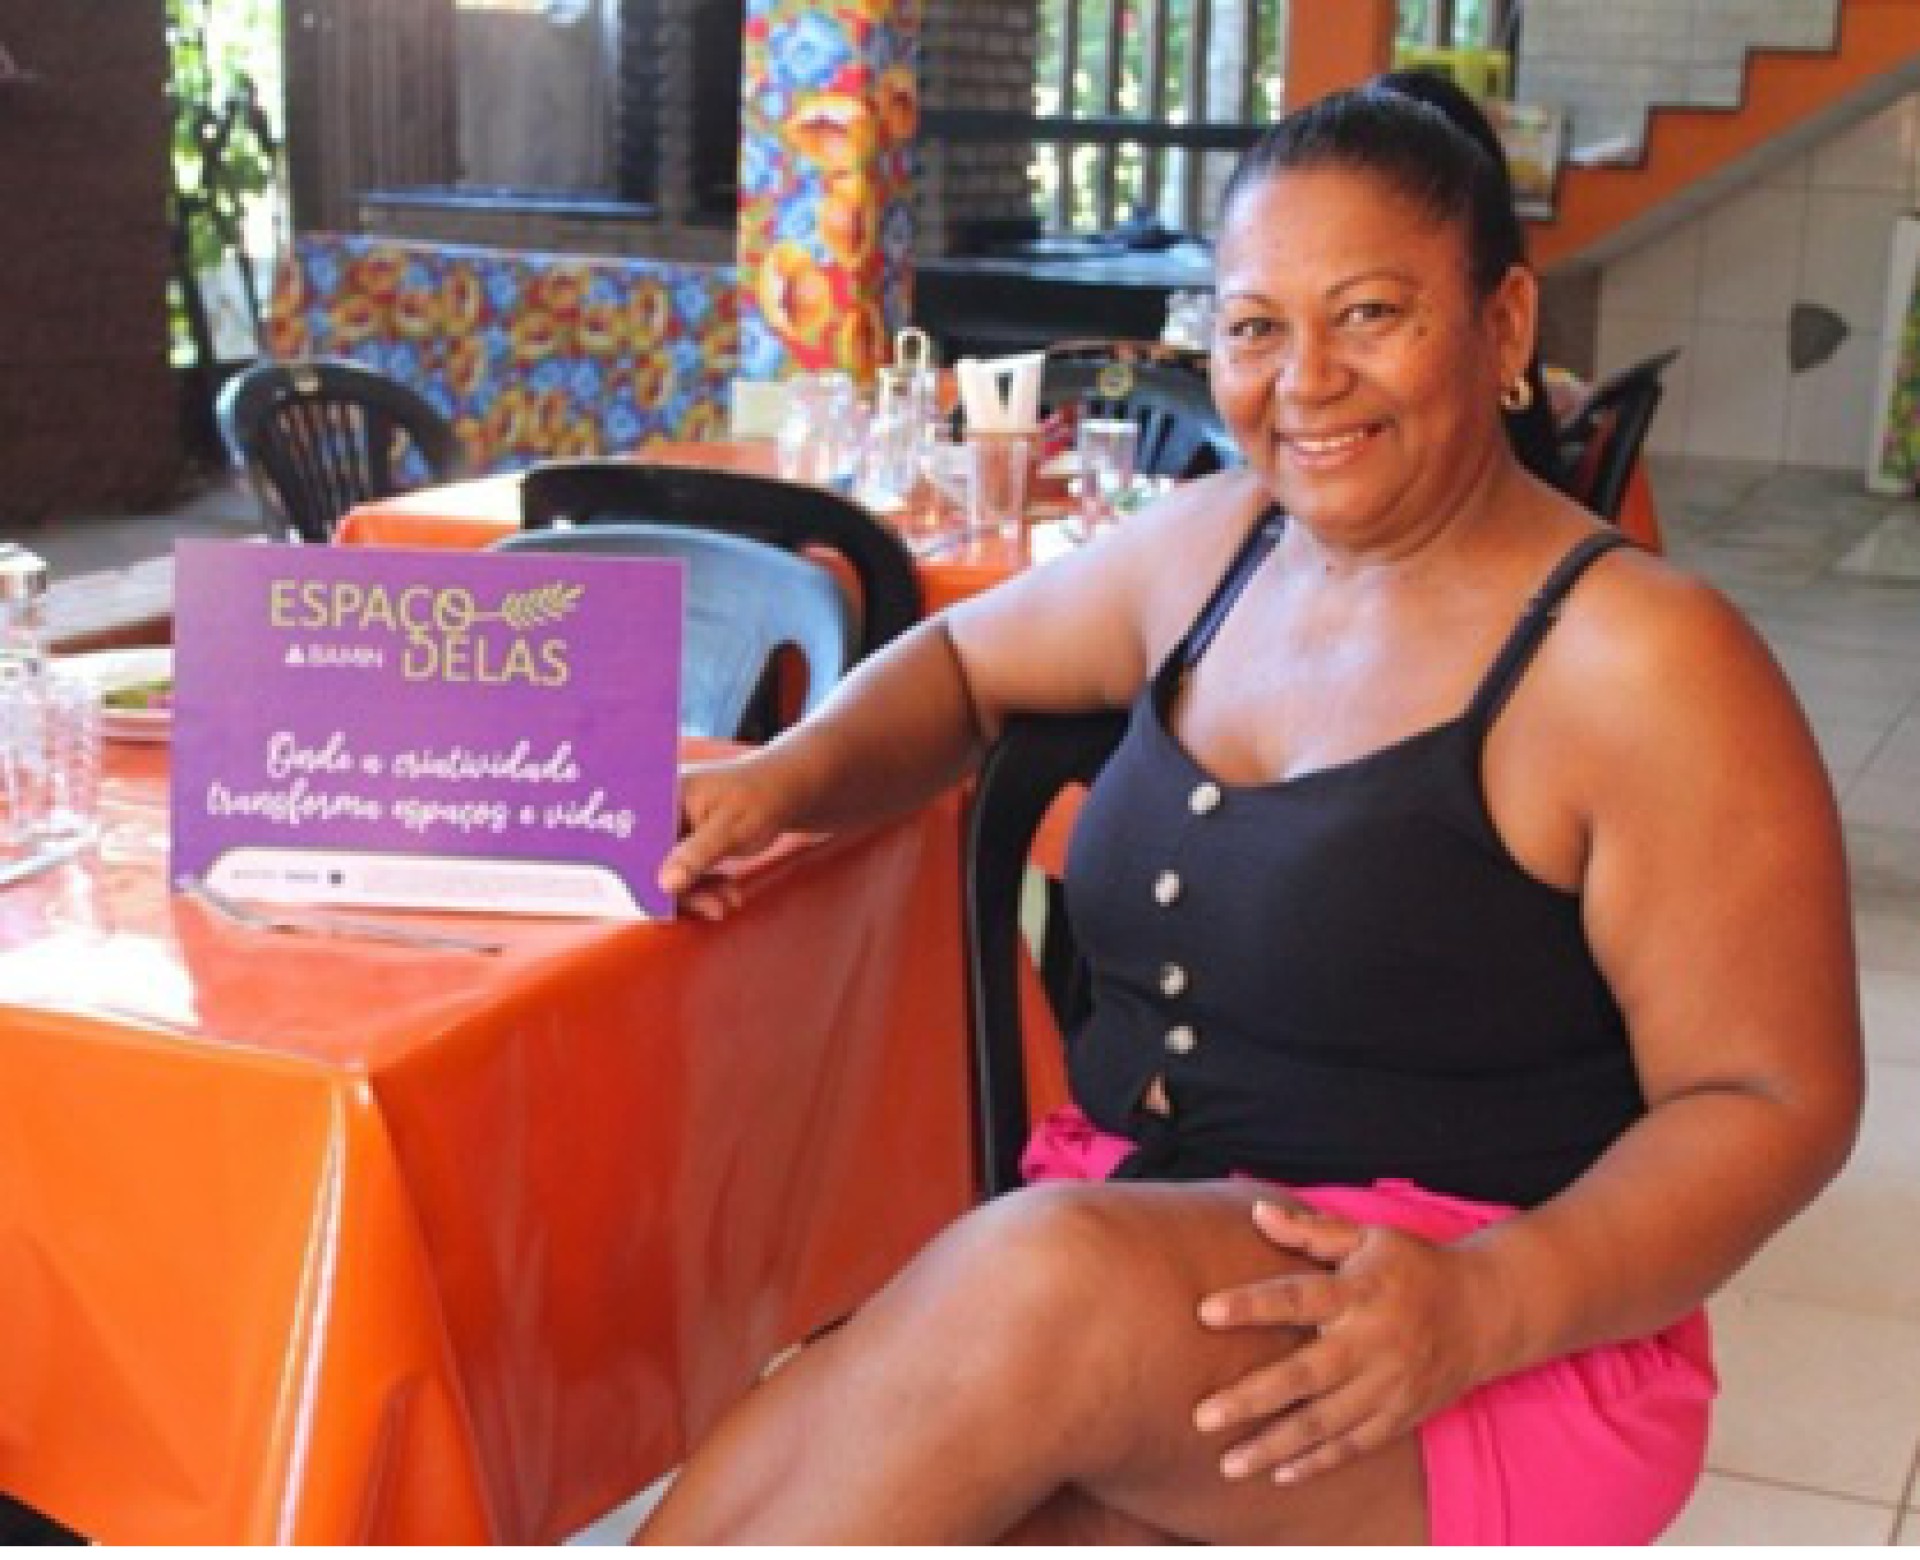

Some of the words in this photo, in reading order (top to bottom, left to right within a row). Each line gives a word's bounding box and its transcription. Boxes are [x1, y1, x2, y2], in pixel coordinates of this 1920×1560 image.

[270, 580, 476, 644] ESPAÇO
[401, 634, 571, 687] DELAS
[206, 779, 382, 826] transforma
[546, 787, 637, 839] vidas
